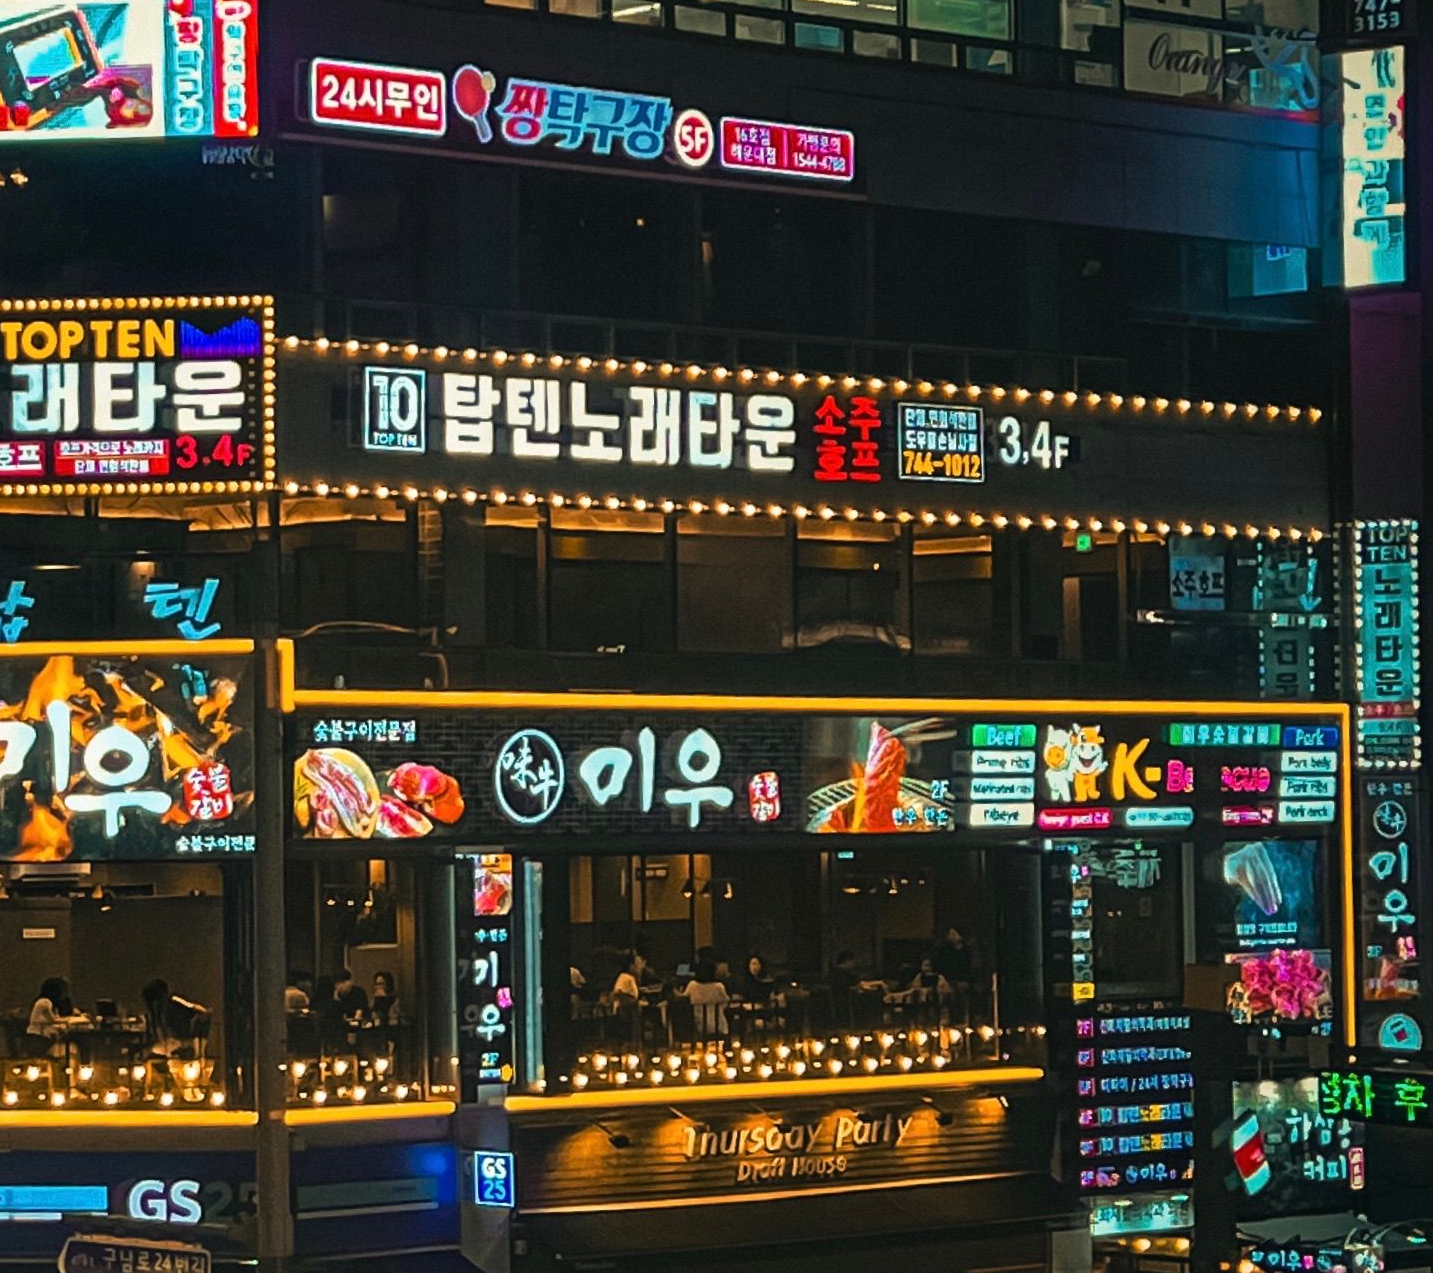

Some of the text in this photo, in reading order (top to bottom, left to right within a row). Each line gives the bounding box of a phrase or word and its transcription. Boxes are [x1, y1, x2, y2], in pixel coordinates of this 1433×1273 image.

[1354, 12, 1401, 32] 3153
[321, 76, 441, 122] 24시무인
[502, 83, 673, 155] 짱탁구장
[680, 123, 708, 154] 5F
[0, 319, 176, 360] TOP TEN
[371, 377, 417, 430] 10
[443, 373, 795, 471] 탑텐노래타운
[814, 395, 880, 436] 소주
[814, 440, 881, 482] 호프
[999, 416, 1069, 469] 3,4F
[903, 451, 981, 477] 744-1012
[1368, 528, 1407, 542] TOP
[1368, 544, 1407, 560] TEN
[1374, 568, 1403, 696] 노래타운
[314, 721, 416, 742] 숯불구이전문점
[987, 730, 1021, 746] Beef
[1296, 728, 1324, 745] Pork
[501, 736, 557, 810] 味牛
[579, 726, 733, 827] 미우
[1369, 842, 1415, 932] 미우
[682, 1122, 912, 1168] Thursday Party
[791, 1154, 848, 1175] House
[481, 1158, 506, 1177] GS
[1303, 1155, 1347, 1181] 커피
[482, 1180, 506, 1200] 25
